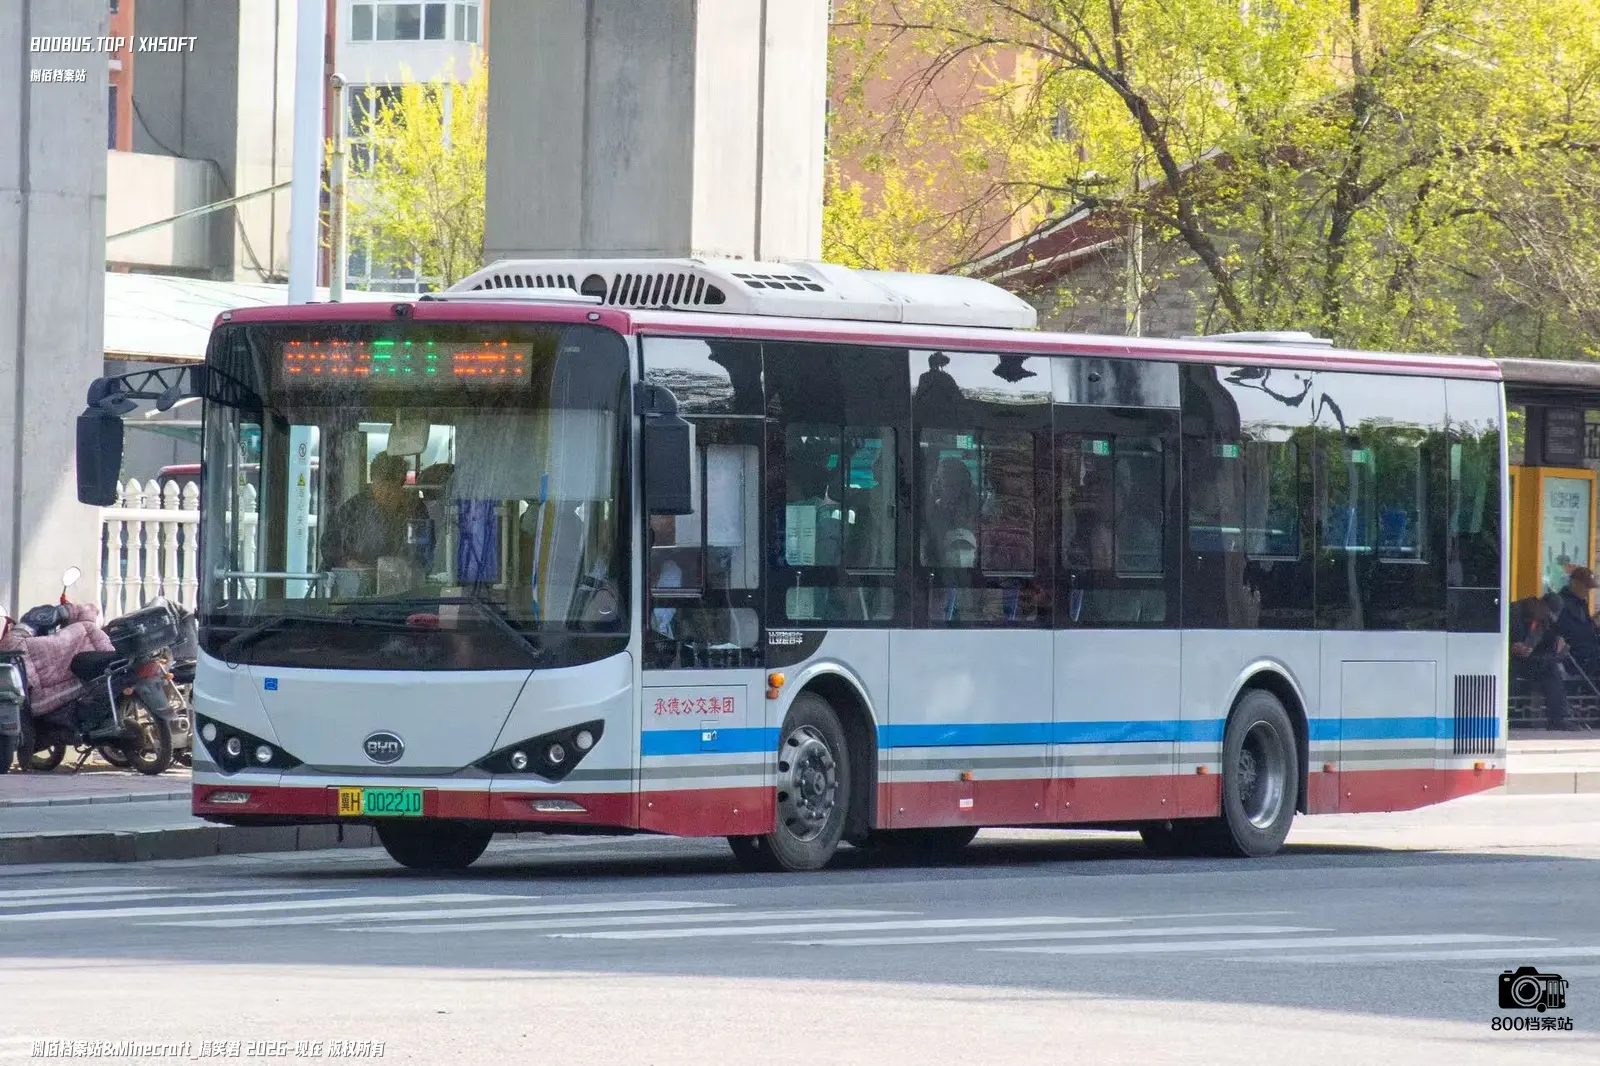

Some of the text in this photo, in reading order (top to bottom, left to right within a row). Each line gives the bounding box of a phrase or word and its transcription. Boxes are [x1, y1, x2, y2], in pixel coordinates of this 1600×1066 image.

[653, 696, 735, 715] 承德公交集团
[367, 741, 398, 753] BYD
